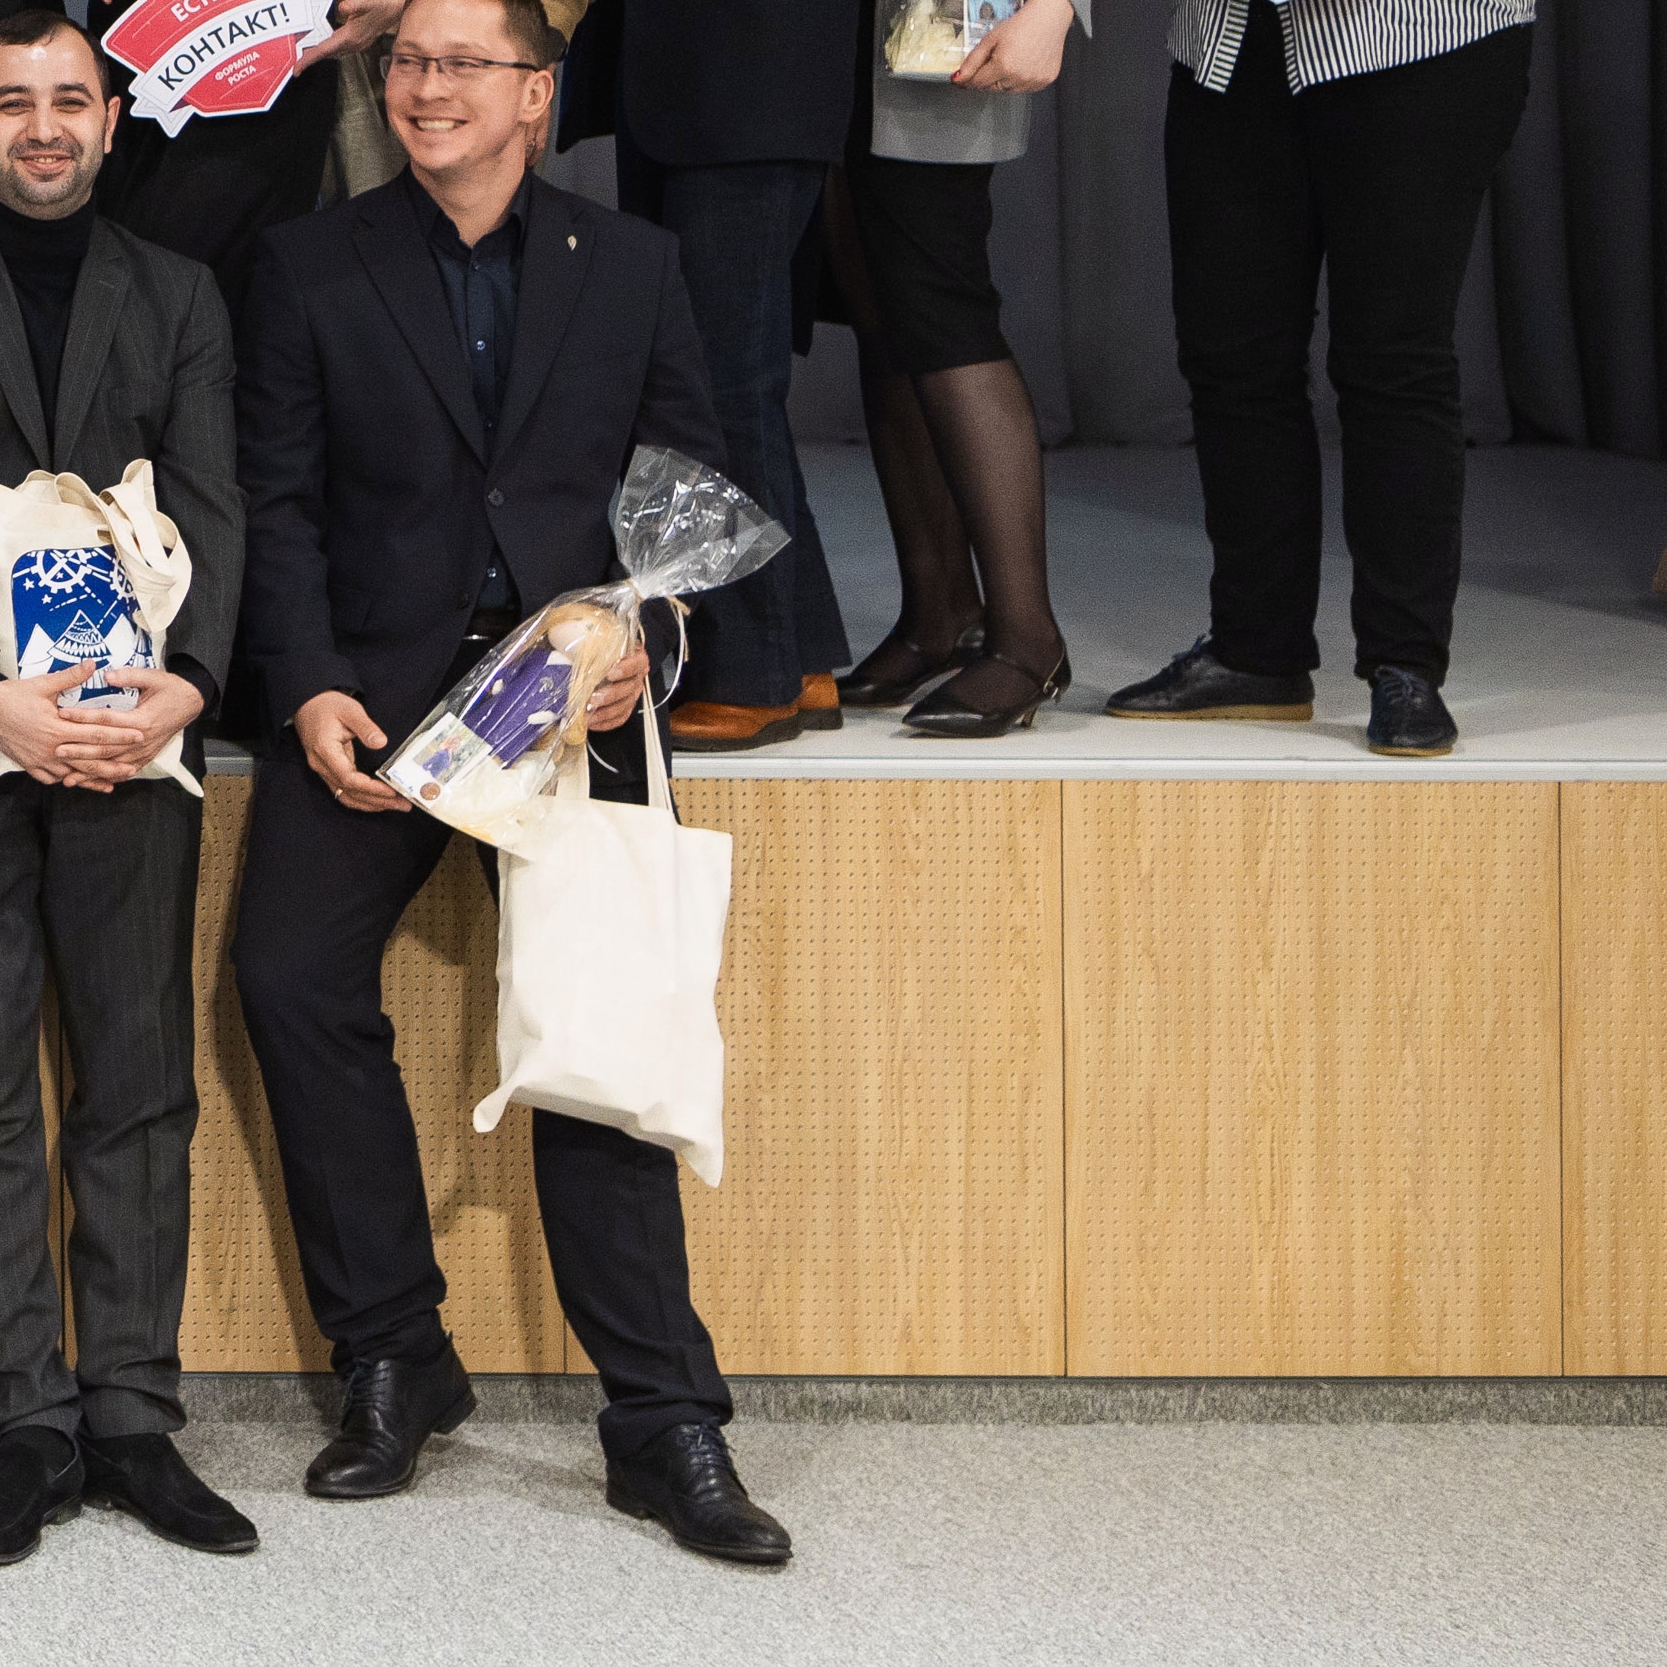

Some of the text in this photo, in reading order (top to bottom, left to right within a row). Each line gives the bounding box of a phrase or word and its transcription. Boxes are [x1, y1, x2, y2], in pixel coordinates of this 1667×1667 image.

[157, 2, 291, 92] КОНТАКТ!
[214, 50, 261, 81] ФОРМУЛА
[227, 64, 257, 86] РОСТА
